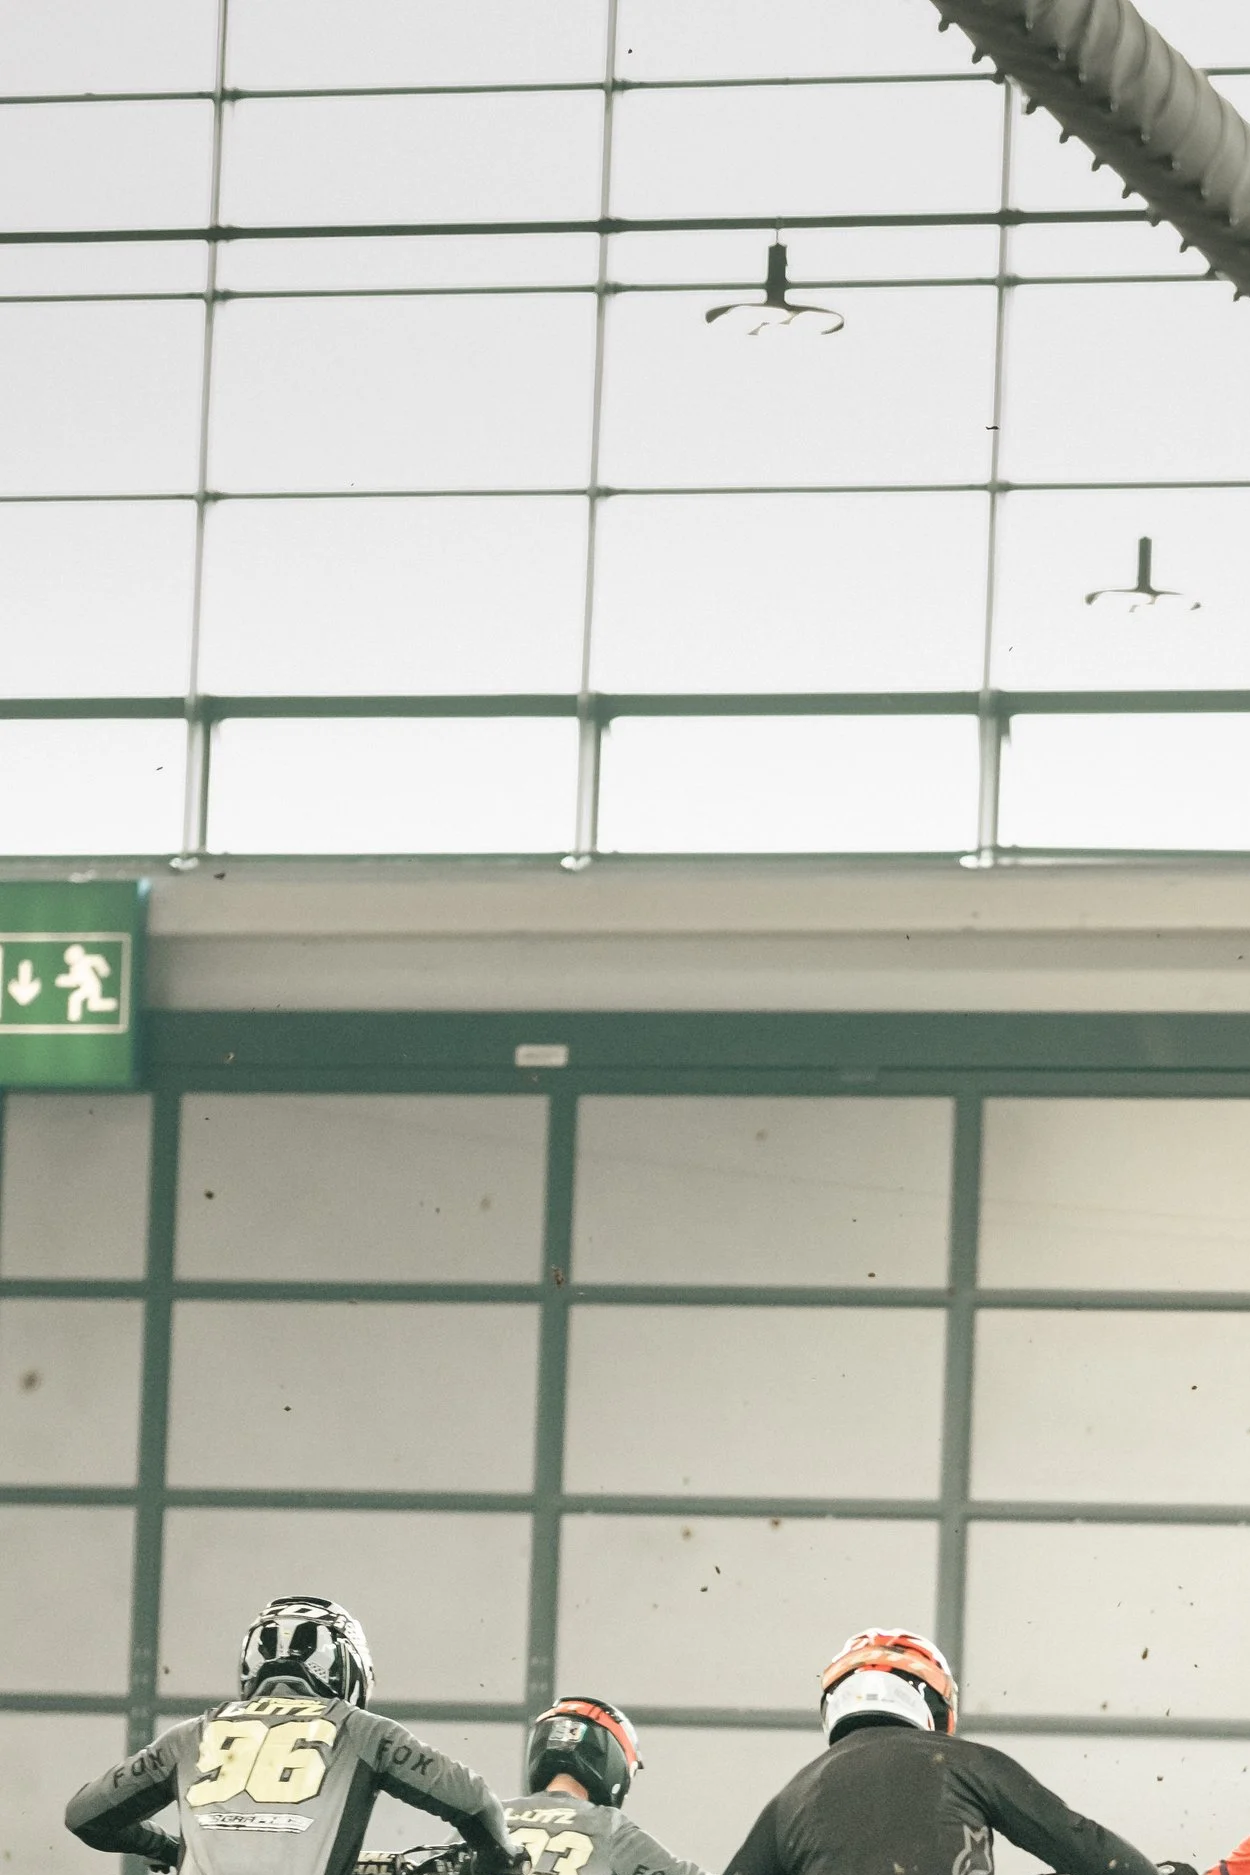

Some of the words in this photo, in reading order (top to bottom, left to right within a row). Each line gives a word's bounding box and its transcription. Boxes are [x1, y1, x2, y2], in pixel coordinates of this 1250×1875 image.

[217, 1698, 328, 1718] LUTZ
[112, 1748, 164, 1789] FOX
[186, 1719, 337, 1808] 96
[375, 1737, 434, 1776] FOX
[504, 1808, 578, 1825] LUTZ
